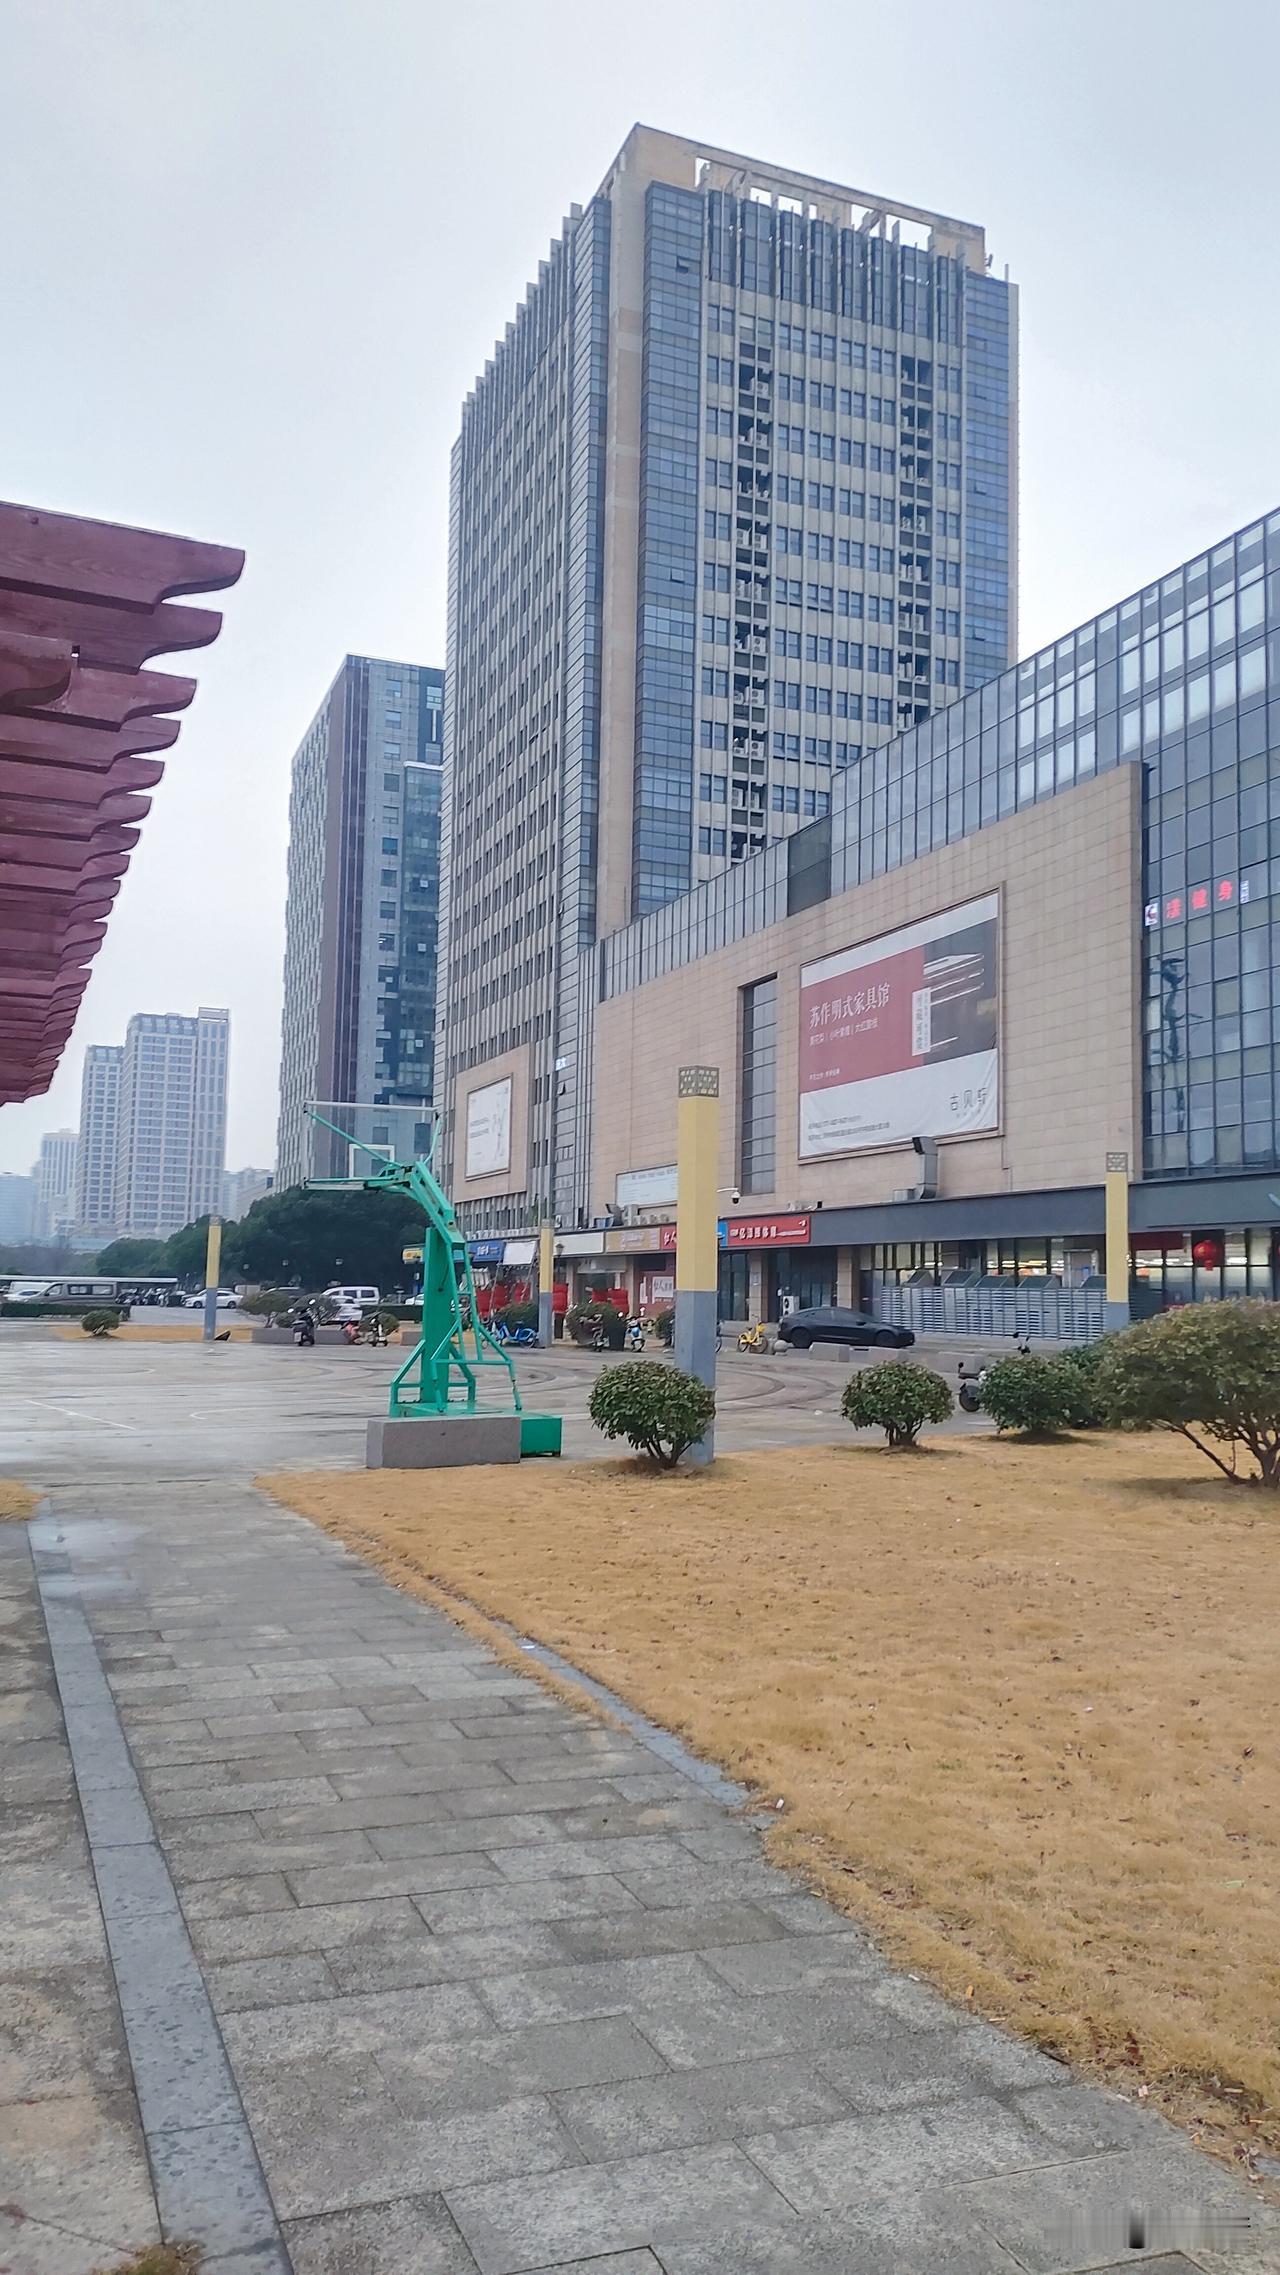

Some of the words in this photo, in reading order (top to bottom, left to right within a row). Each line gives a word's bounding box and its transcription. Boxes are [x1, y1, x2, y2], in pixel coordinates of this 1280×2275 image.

[808, 982, 890, 1031] 苏作明式家具馆
